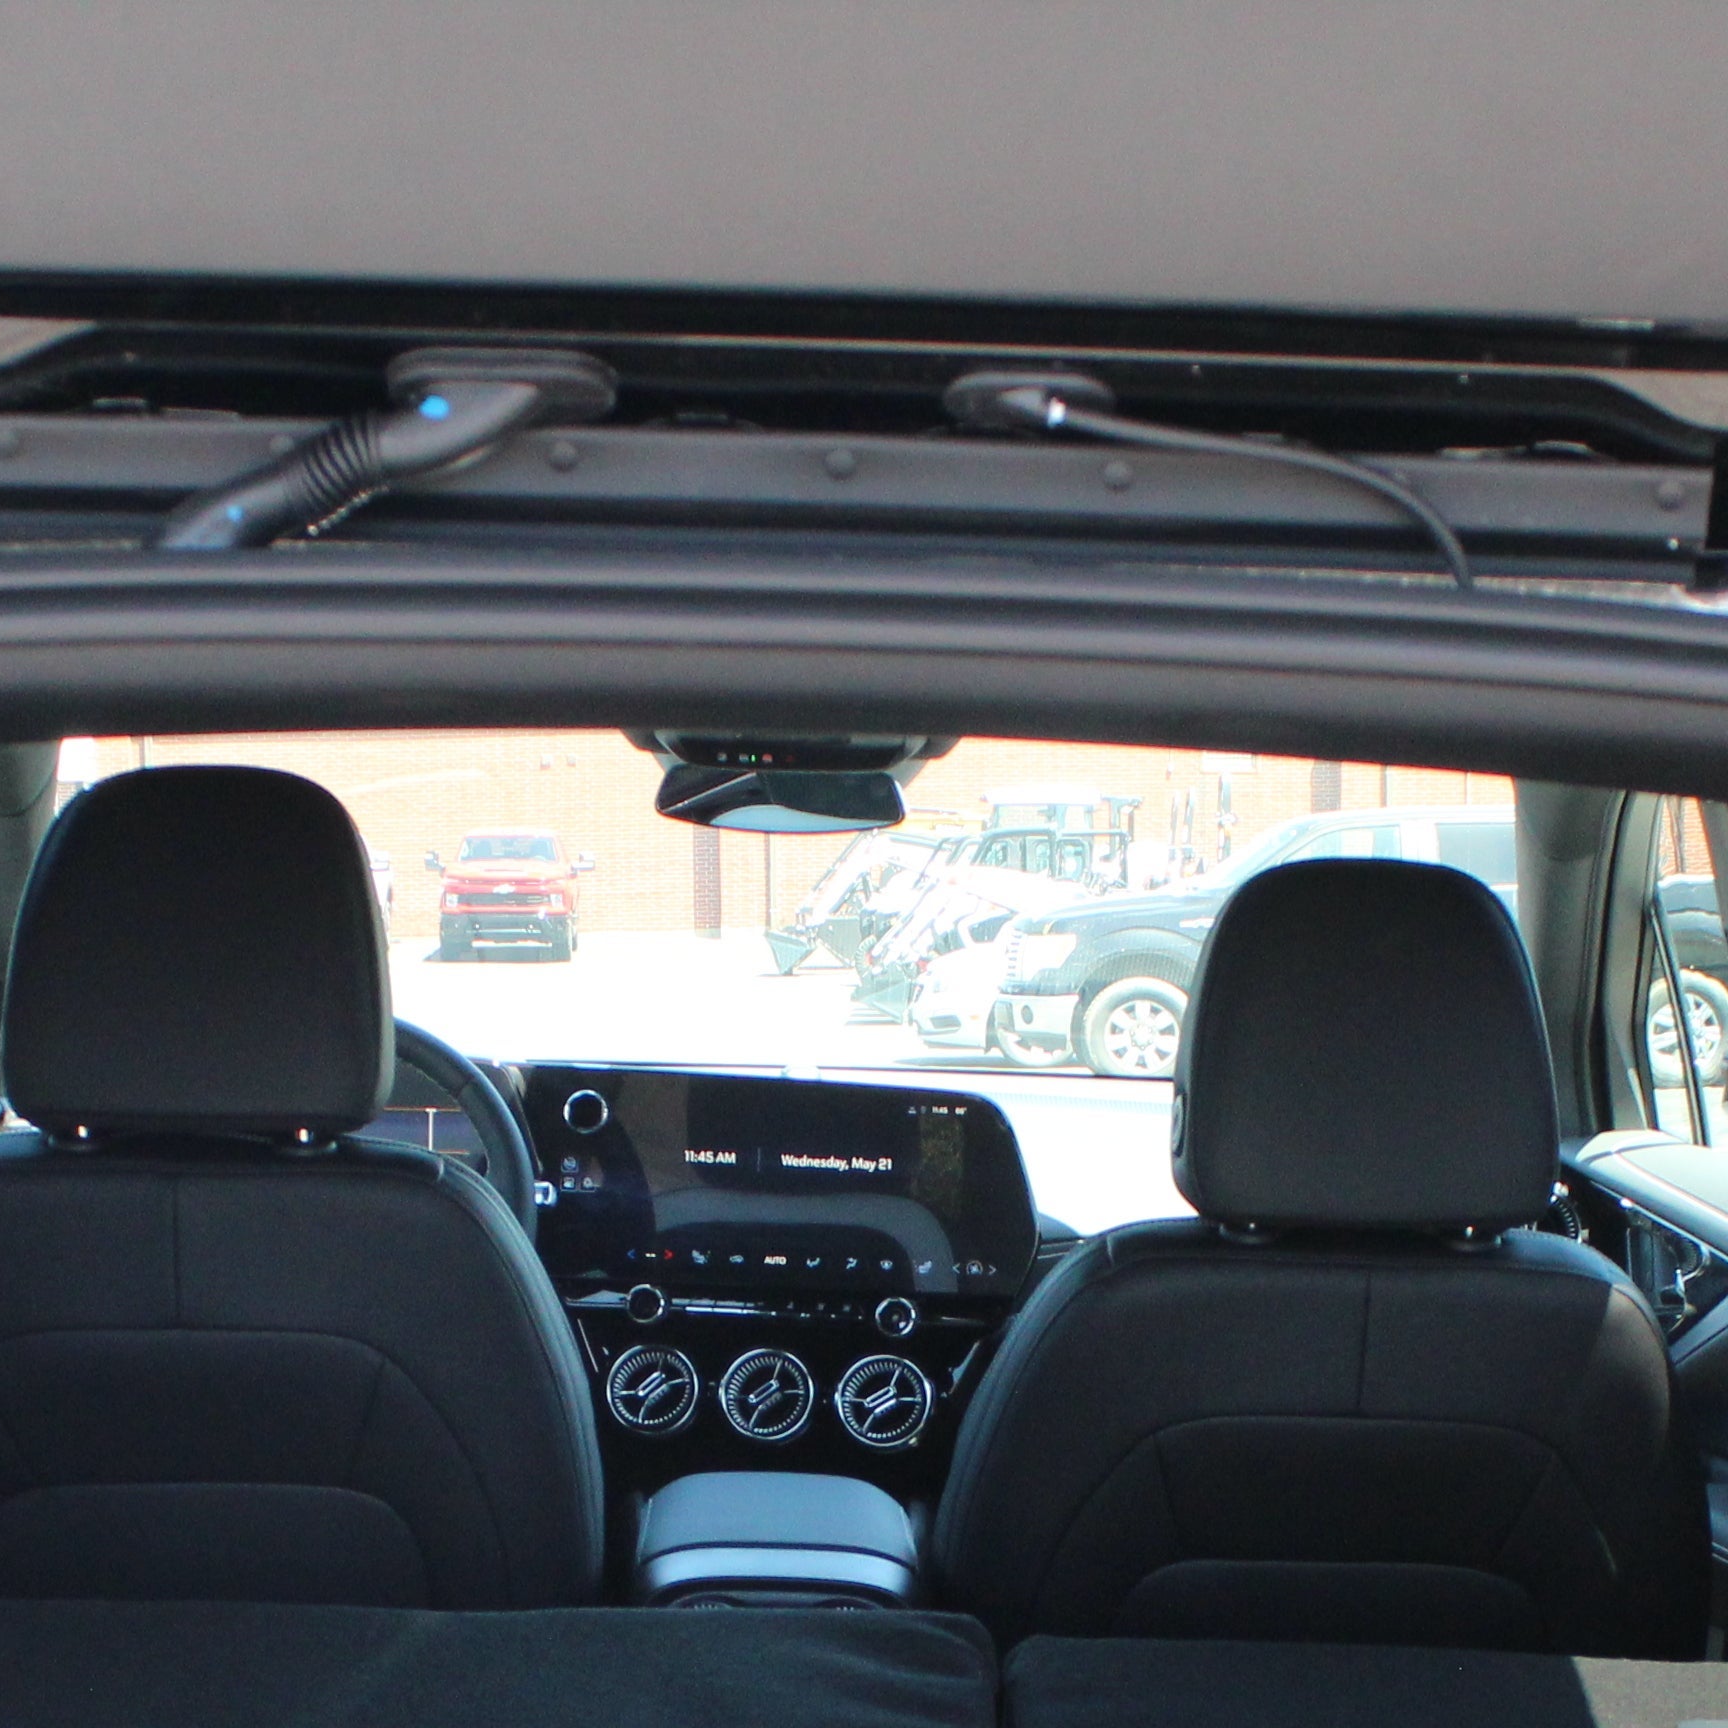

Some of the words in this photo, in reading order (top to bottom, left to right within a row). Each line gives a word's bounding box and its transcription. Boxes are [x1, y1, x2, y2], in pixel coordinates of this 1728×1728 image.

[684, 1150, 714, 1164] 11:45
[715, 1152, 737, 1165] AM
[781, 1154, 850, 1172] Wednesday,
[851, 1157, 877, 1173] May
[877, 1157, 893, 1171] 21
[764, 1256, 787, 1265] AUTO
